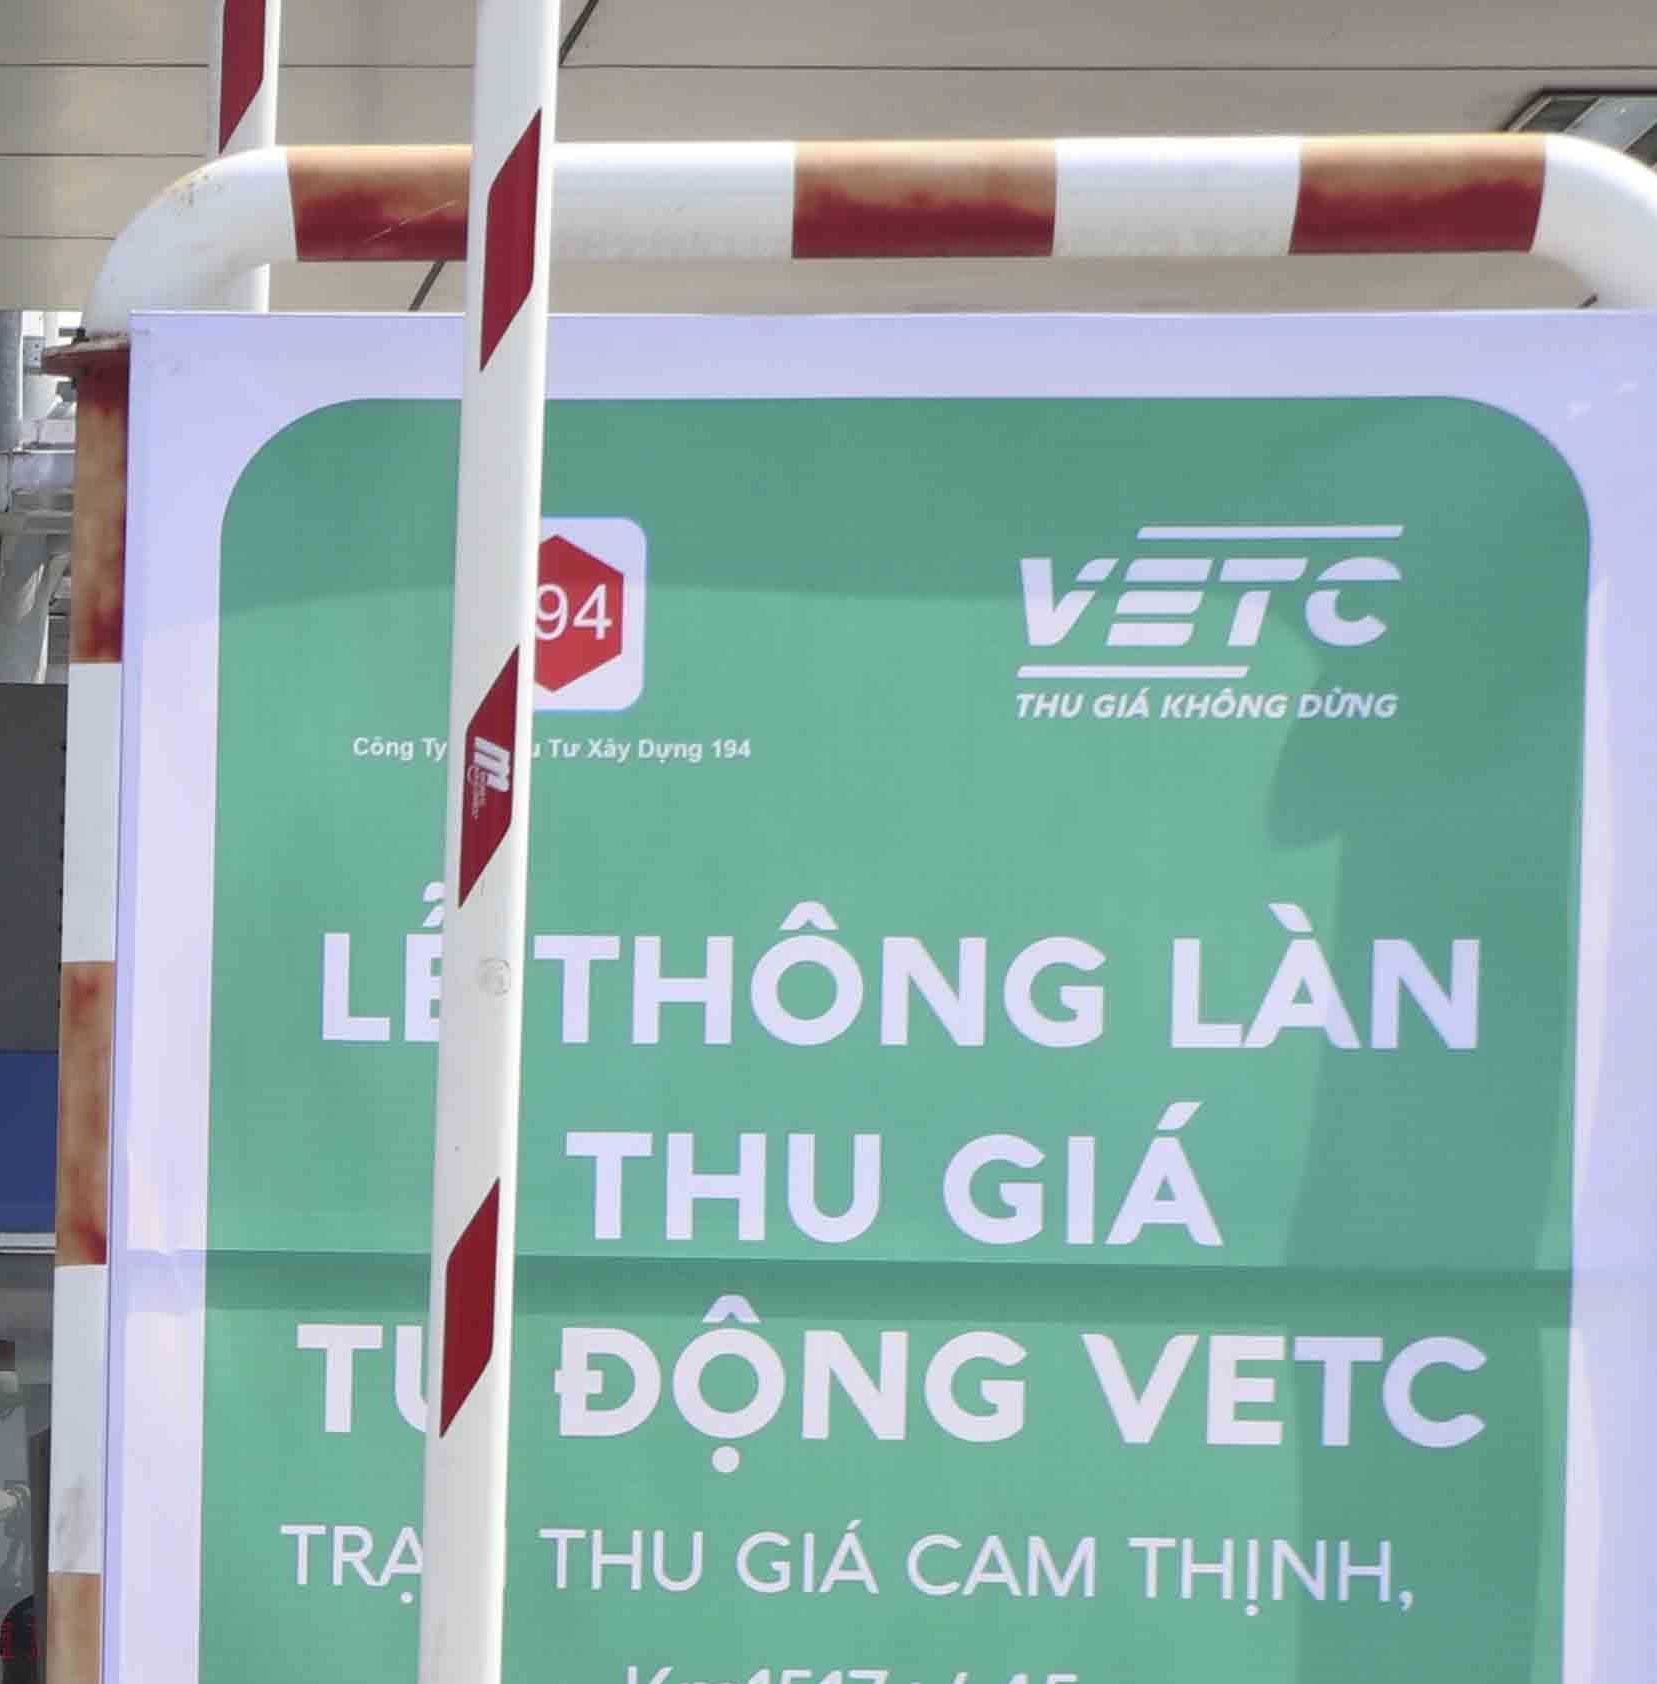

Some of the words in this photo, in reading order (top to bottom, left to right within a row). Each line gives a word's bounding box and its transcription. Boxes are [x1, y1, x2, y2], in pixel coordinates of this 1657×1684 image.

[536, 583, 613, 641] 94
[1020, 557, 1403, 647] VETC
[1015, 692, 1084, 719] THU
[1092, 687, 1152, 719] GIÁ
[1160, 688, 1288, 720] KHÔNG
[1297, 686, 1400, 720] DỪNG
[352, 736, 414, 760] Công
[421, 737, 447, 761] Ty
[547, 739, 578, 759] Tư
[586, 738, 630, 763] Xây
[637, 738, 703, 765] Dựng
[711, 739, 752, 759] 194
[534, 901, 1106, 1048] THÔNG
[1170, 902, 1481, 1049] LÀN
[565, 1131, 882, 1243] THU
[943, 1101, 1225, 1248] GIÁ
[554, 1295, 1029, 1474] ĐỘNG
[1084, 1333, 1489, 1449] VETC
[280, 1524, 423, 1604] TRẠ
[539, 1528, 705, 1592] THU
[736, 1519, 880, 1595] GIÁ
[907, 1534, 1097, 1599] CAM
[1128, 1536, 1415, 1618] THỊNH,
